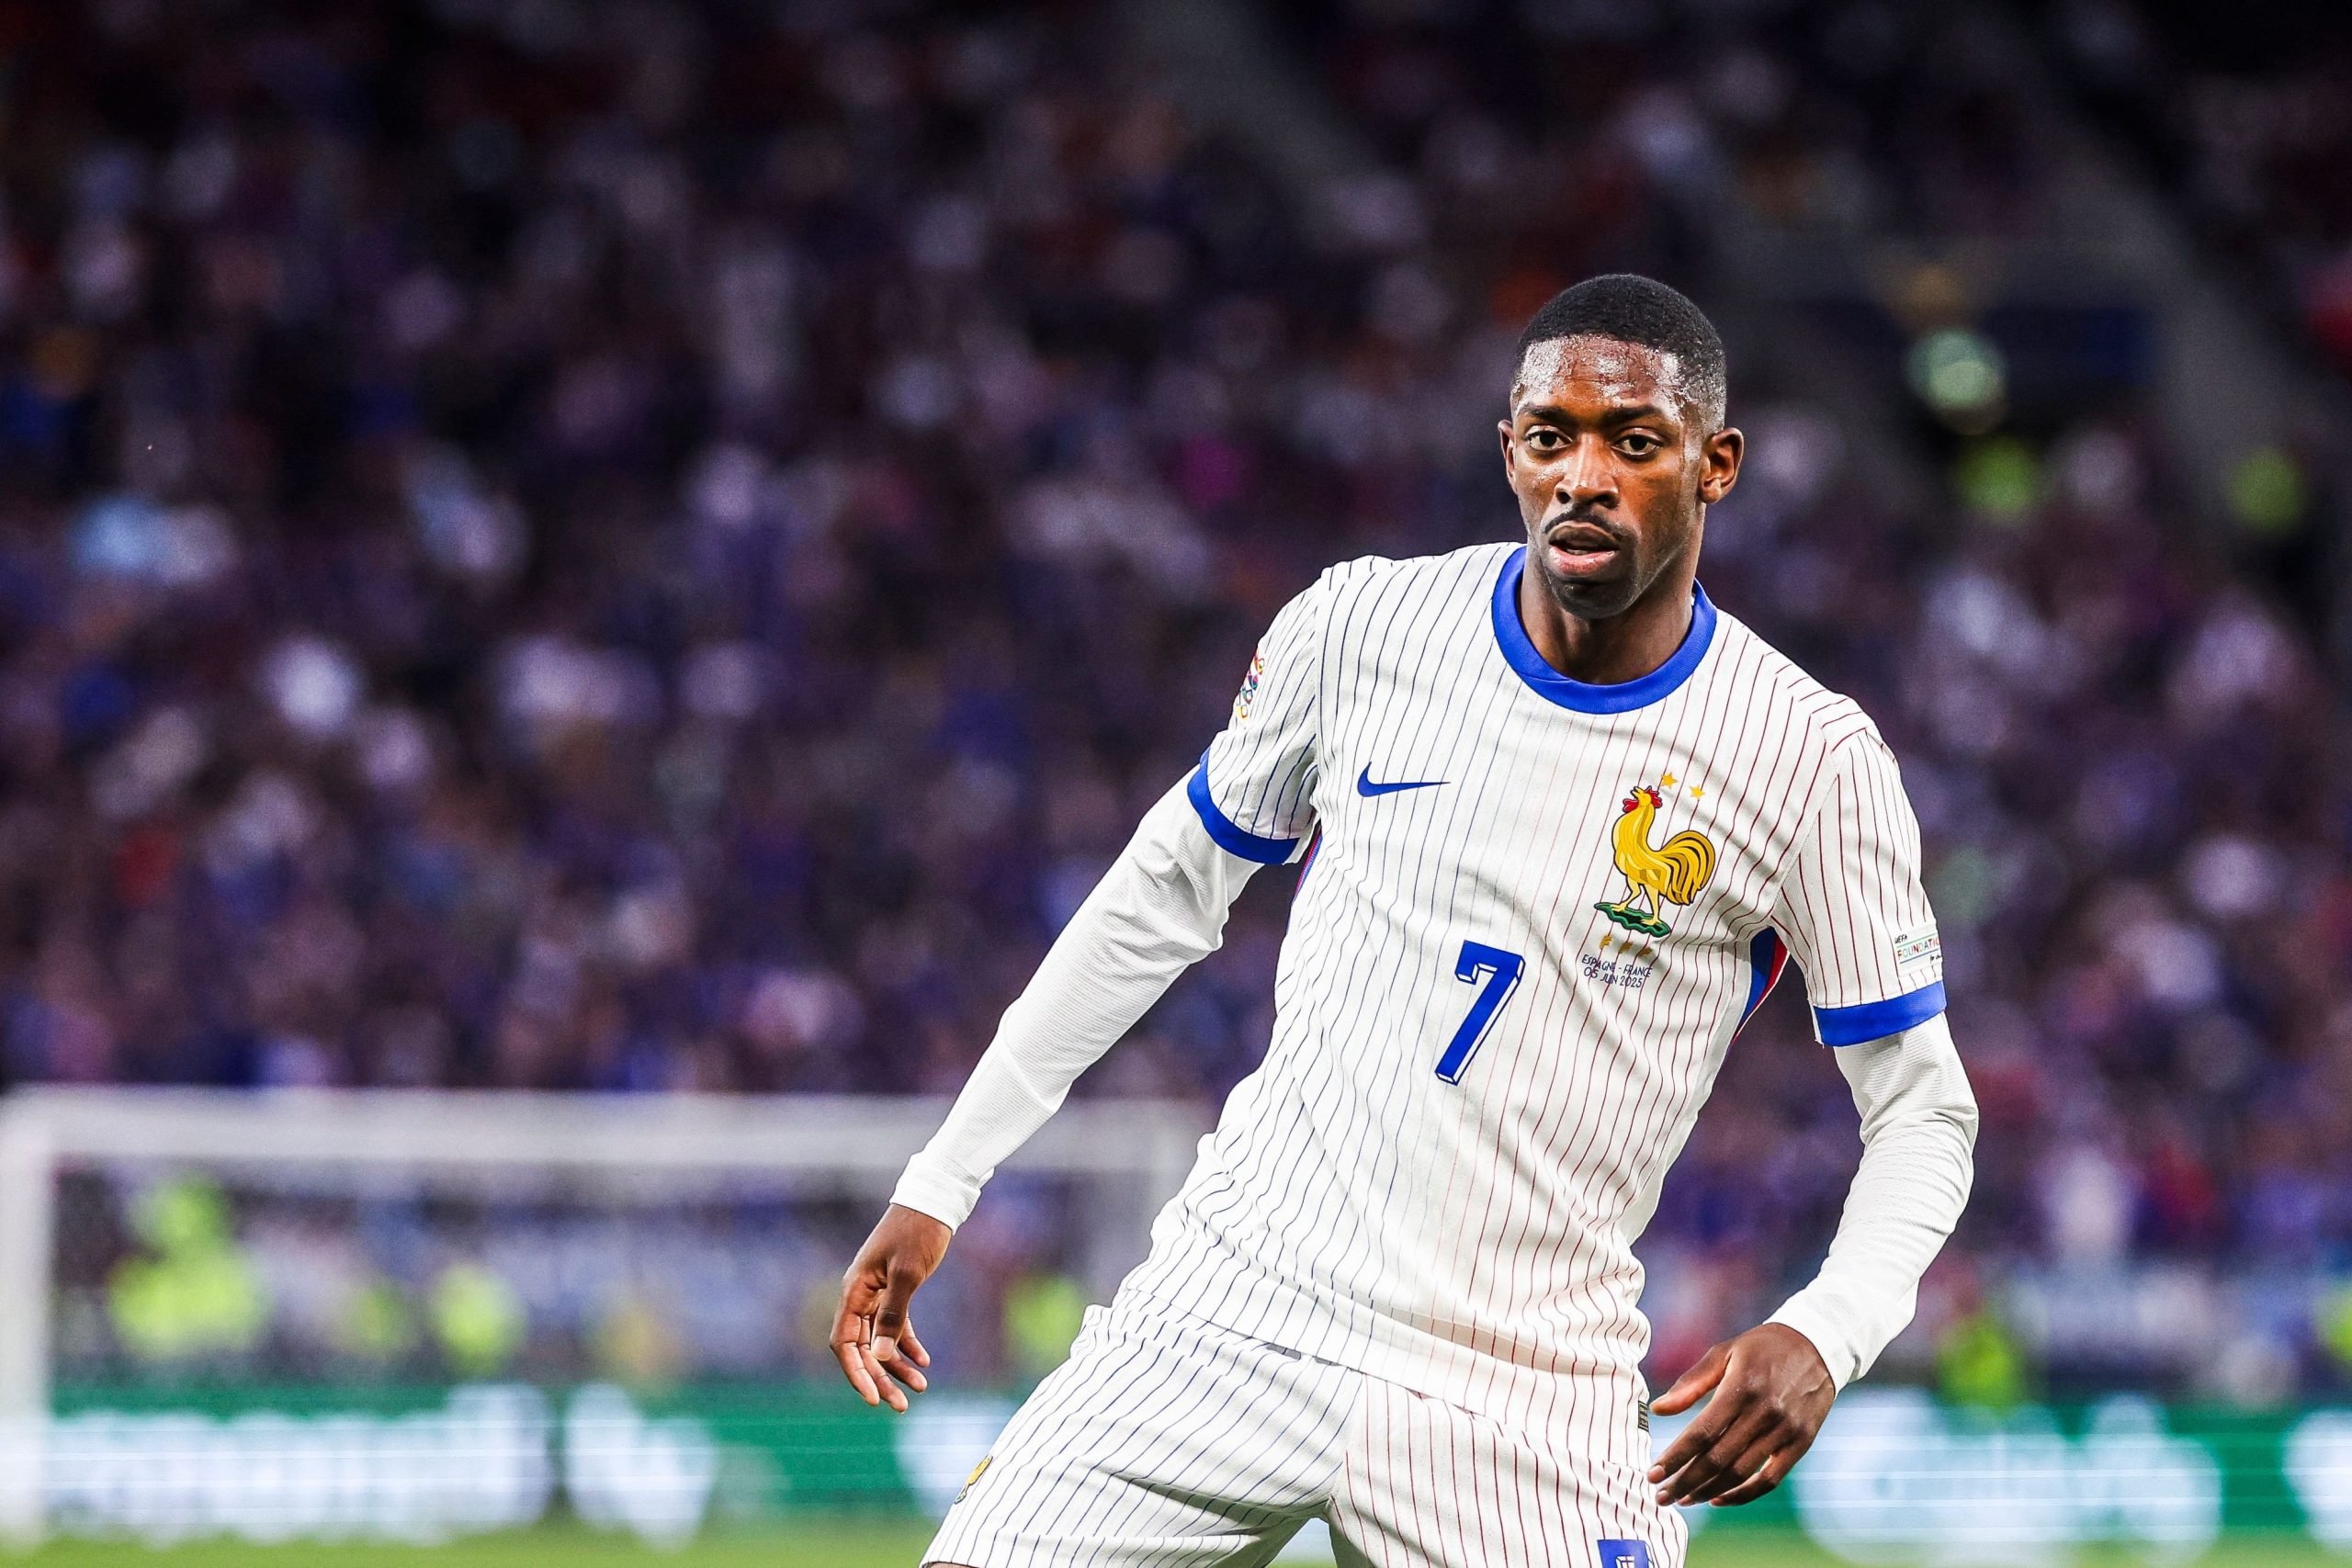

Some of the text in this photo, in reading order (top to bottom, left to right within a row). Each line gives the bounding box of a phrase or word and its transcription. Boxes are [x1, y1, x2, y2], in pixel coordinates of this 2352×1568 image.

[1897, 937, 1939, 960] FOUNDATIO
[1582, 954, 1616, 971] ESPAGNE
[1623, 964, 1653, 977] FRANCE
[1584, 967, 1643, 987] 05 JUIN 2025
[1435, 940, 1526, 1086] 7
